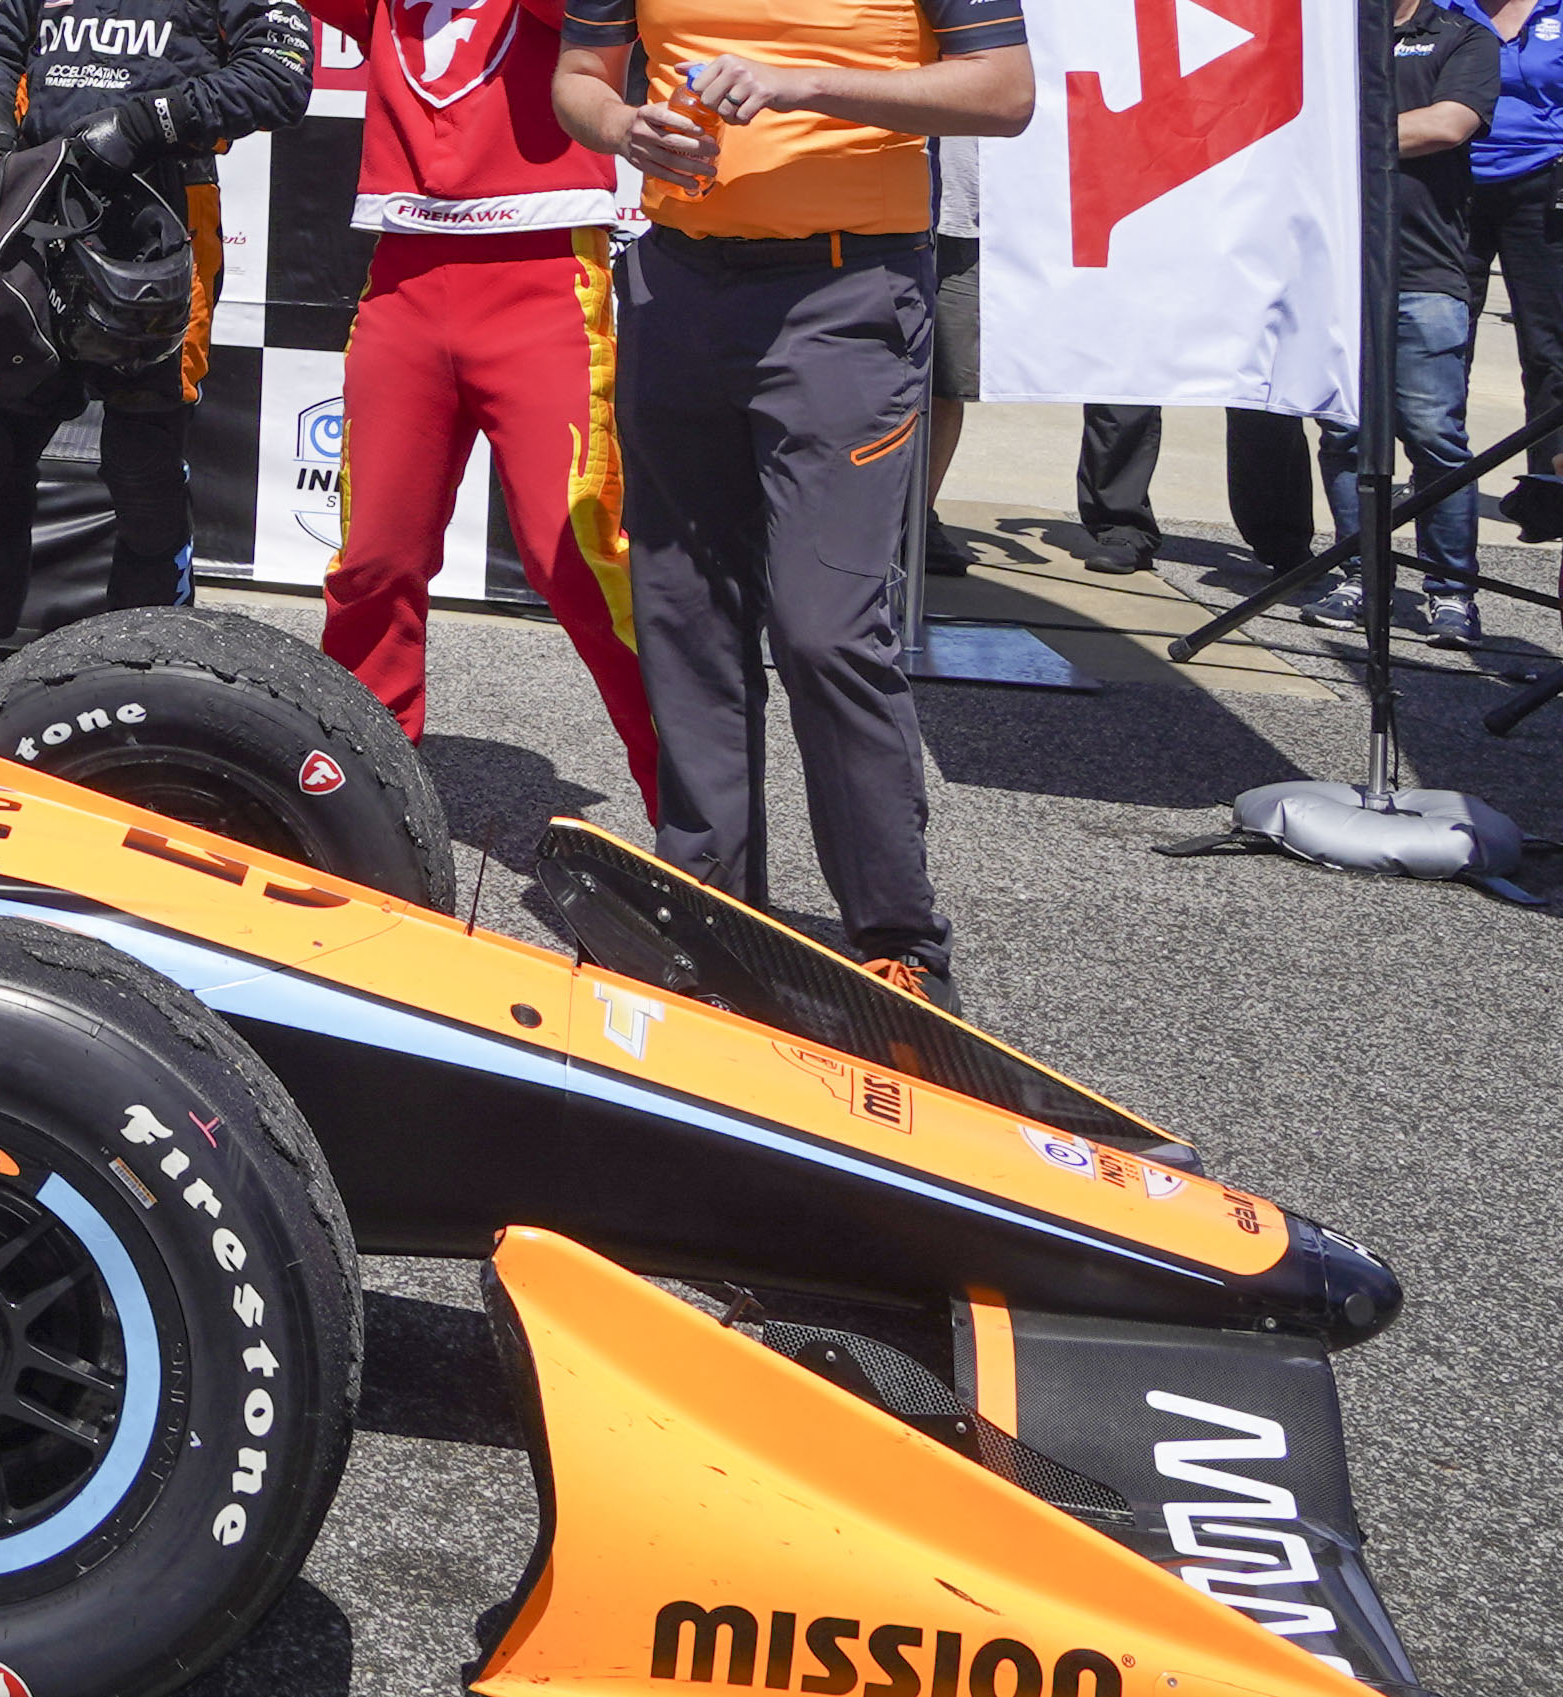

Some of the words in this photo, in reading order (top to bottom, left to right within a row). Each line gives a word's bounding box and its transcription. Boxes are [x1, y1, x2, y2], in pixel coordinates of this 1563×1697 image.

[38, 15, 173, 58] ARROW
[396, 203, 520, 225] FIREHAWK
[120, 1103, 281, 1548] Firestone
[650, 1600, 1124, 1697] MISSION
